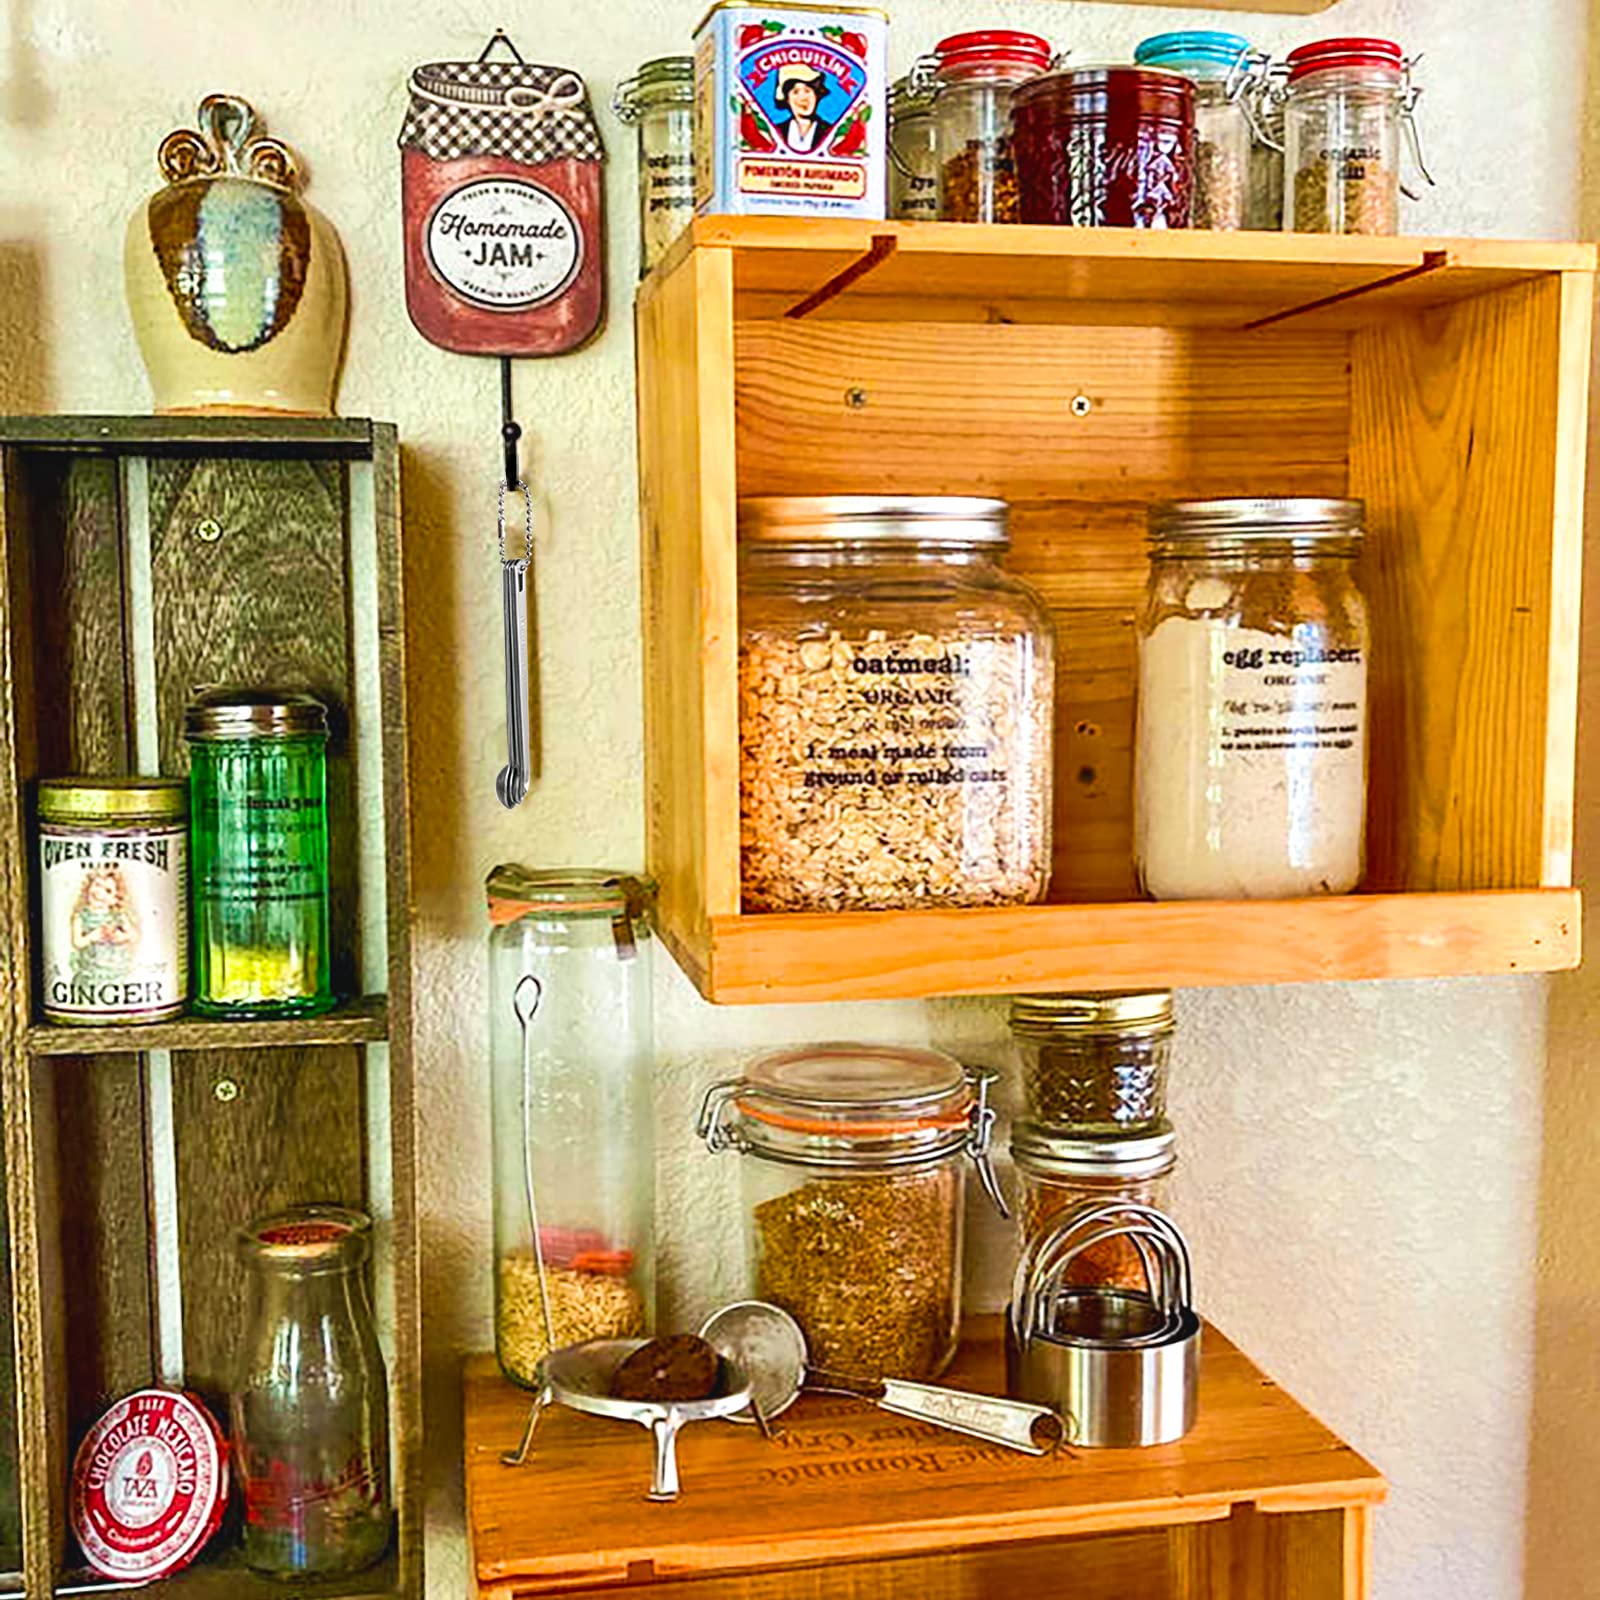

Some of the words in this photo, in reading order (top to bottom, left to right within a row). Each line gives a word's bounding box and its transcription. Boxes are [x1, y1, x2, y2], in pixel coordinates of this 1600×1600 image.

[758, 48, 846, 78] CHIQUILÍN
[439, 211, 568, 242] Homemade
[473, 241, 533, 268] JAM
[1222, 648, 1264, 669] egg
[828, 744, 878, 760] meal
[883, 744, 937, 760] made
[942, 742, 989, 759] from
[803, 768, 877, 788] ground
[880, 770, 903, 784] or
[907, 767, 965, 785] rolled
[44, 839, 92, 870] OVEN
[101, 839, 169, 871] FRESH
[51, 981, 163, 1006] GINGER
[87, 1413, 150, 1490] CHOCOLATE
[153, 1416, 195, 1496] MEXICANO
